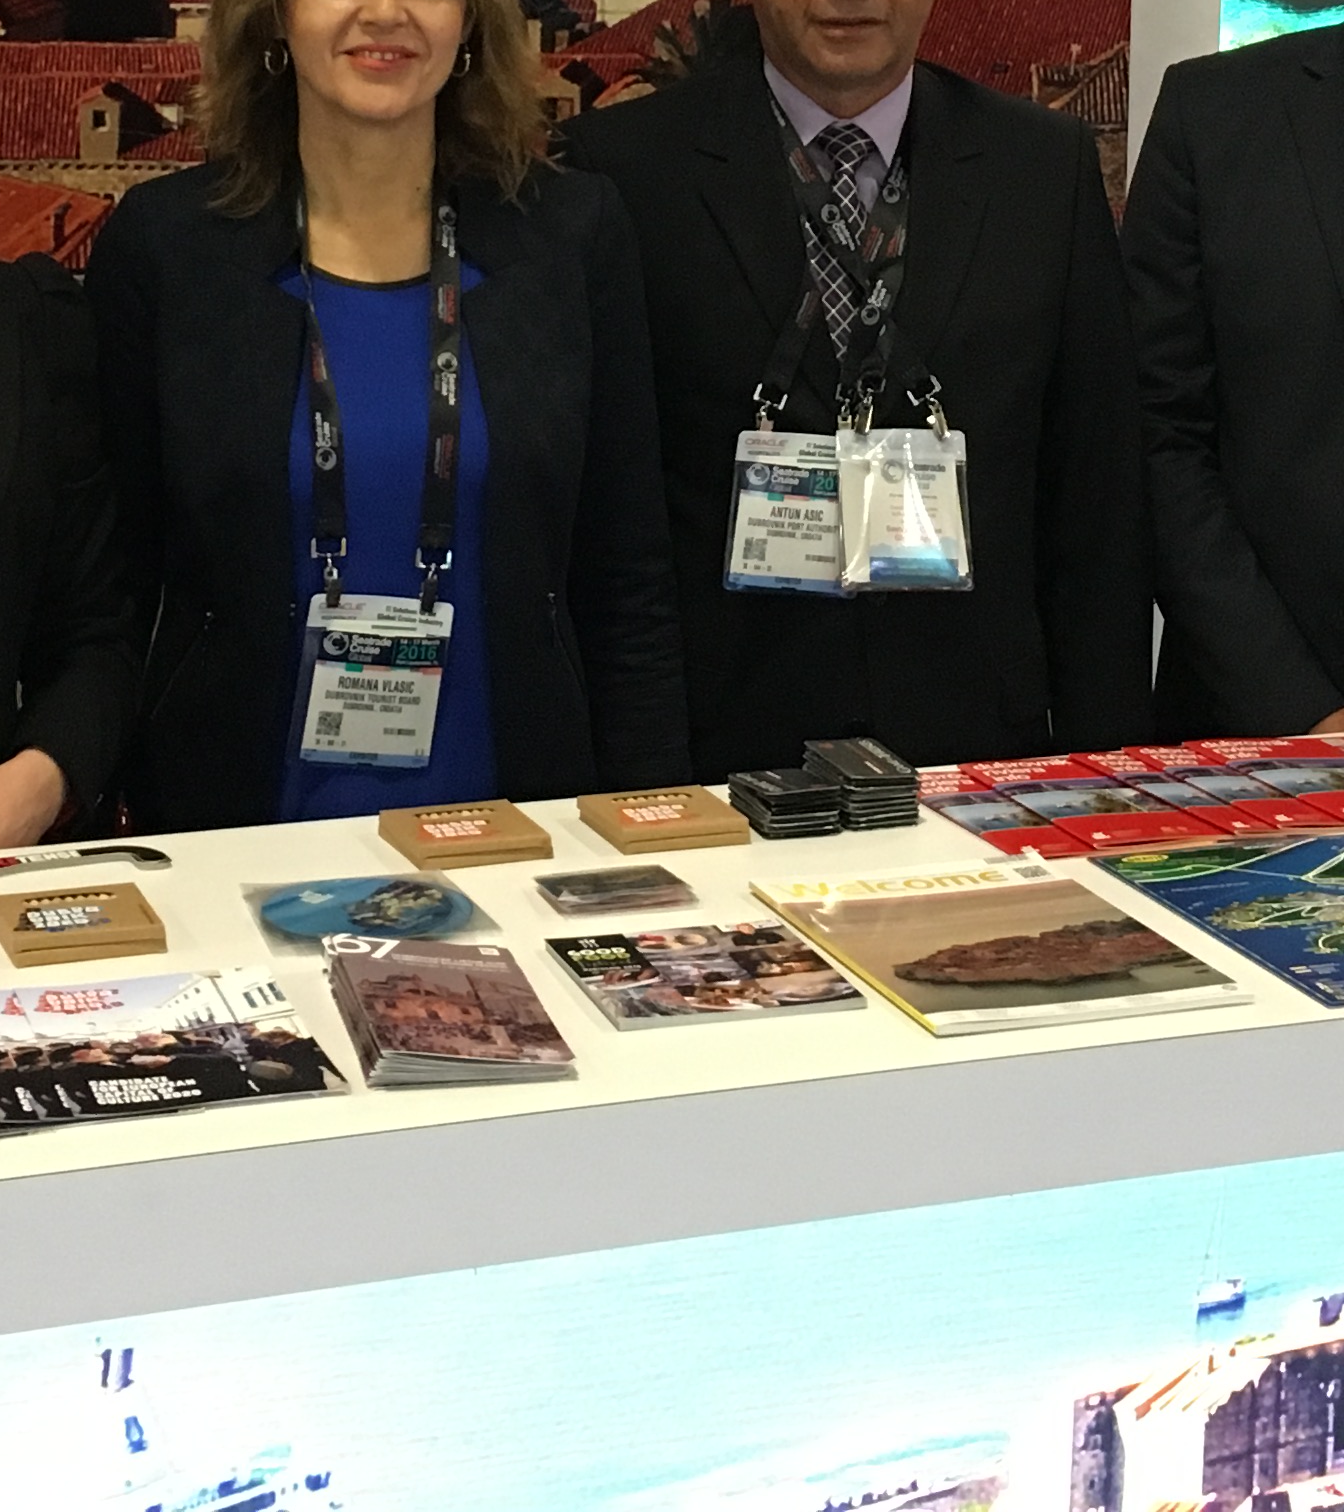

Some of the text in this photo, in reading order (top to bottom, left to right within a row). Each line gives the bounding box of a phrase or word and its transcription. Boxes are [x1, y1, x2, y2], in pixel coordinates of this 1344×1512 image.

[770, 505, 824, 523] ANTUN ASIC
[396, 645, 438, 661] 2016
[337, 675, 379, 692] ROMANA
[973, 759, 1072, 771] dubrovnik
[982, 767, 1047, 777] riviera
[993, 774, 1031, 782] info
[87, 1075, 169, 1087] CANDIDATE
[96, 1093, 160, 1105] CULTURE
